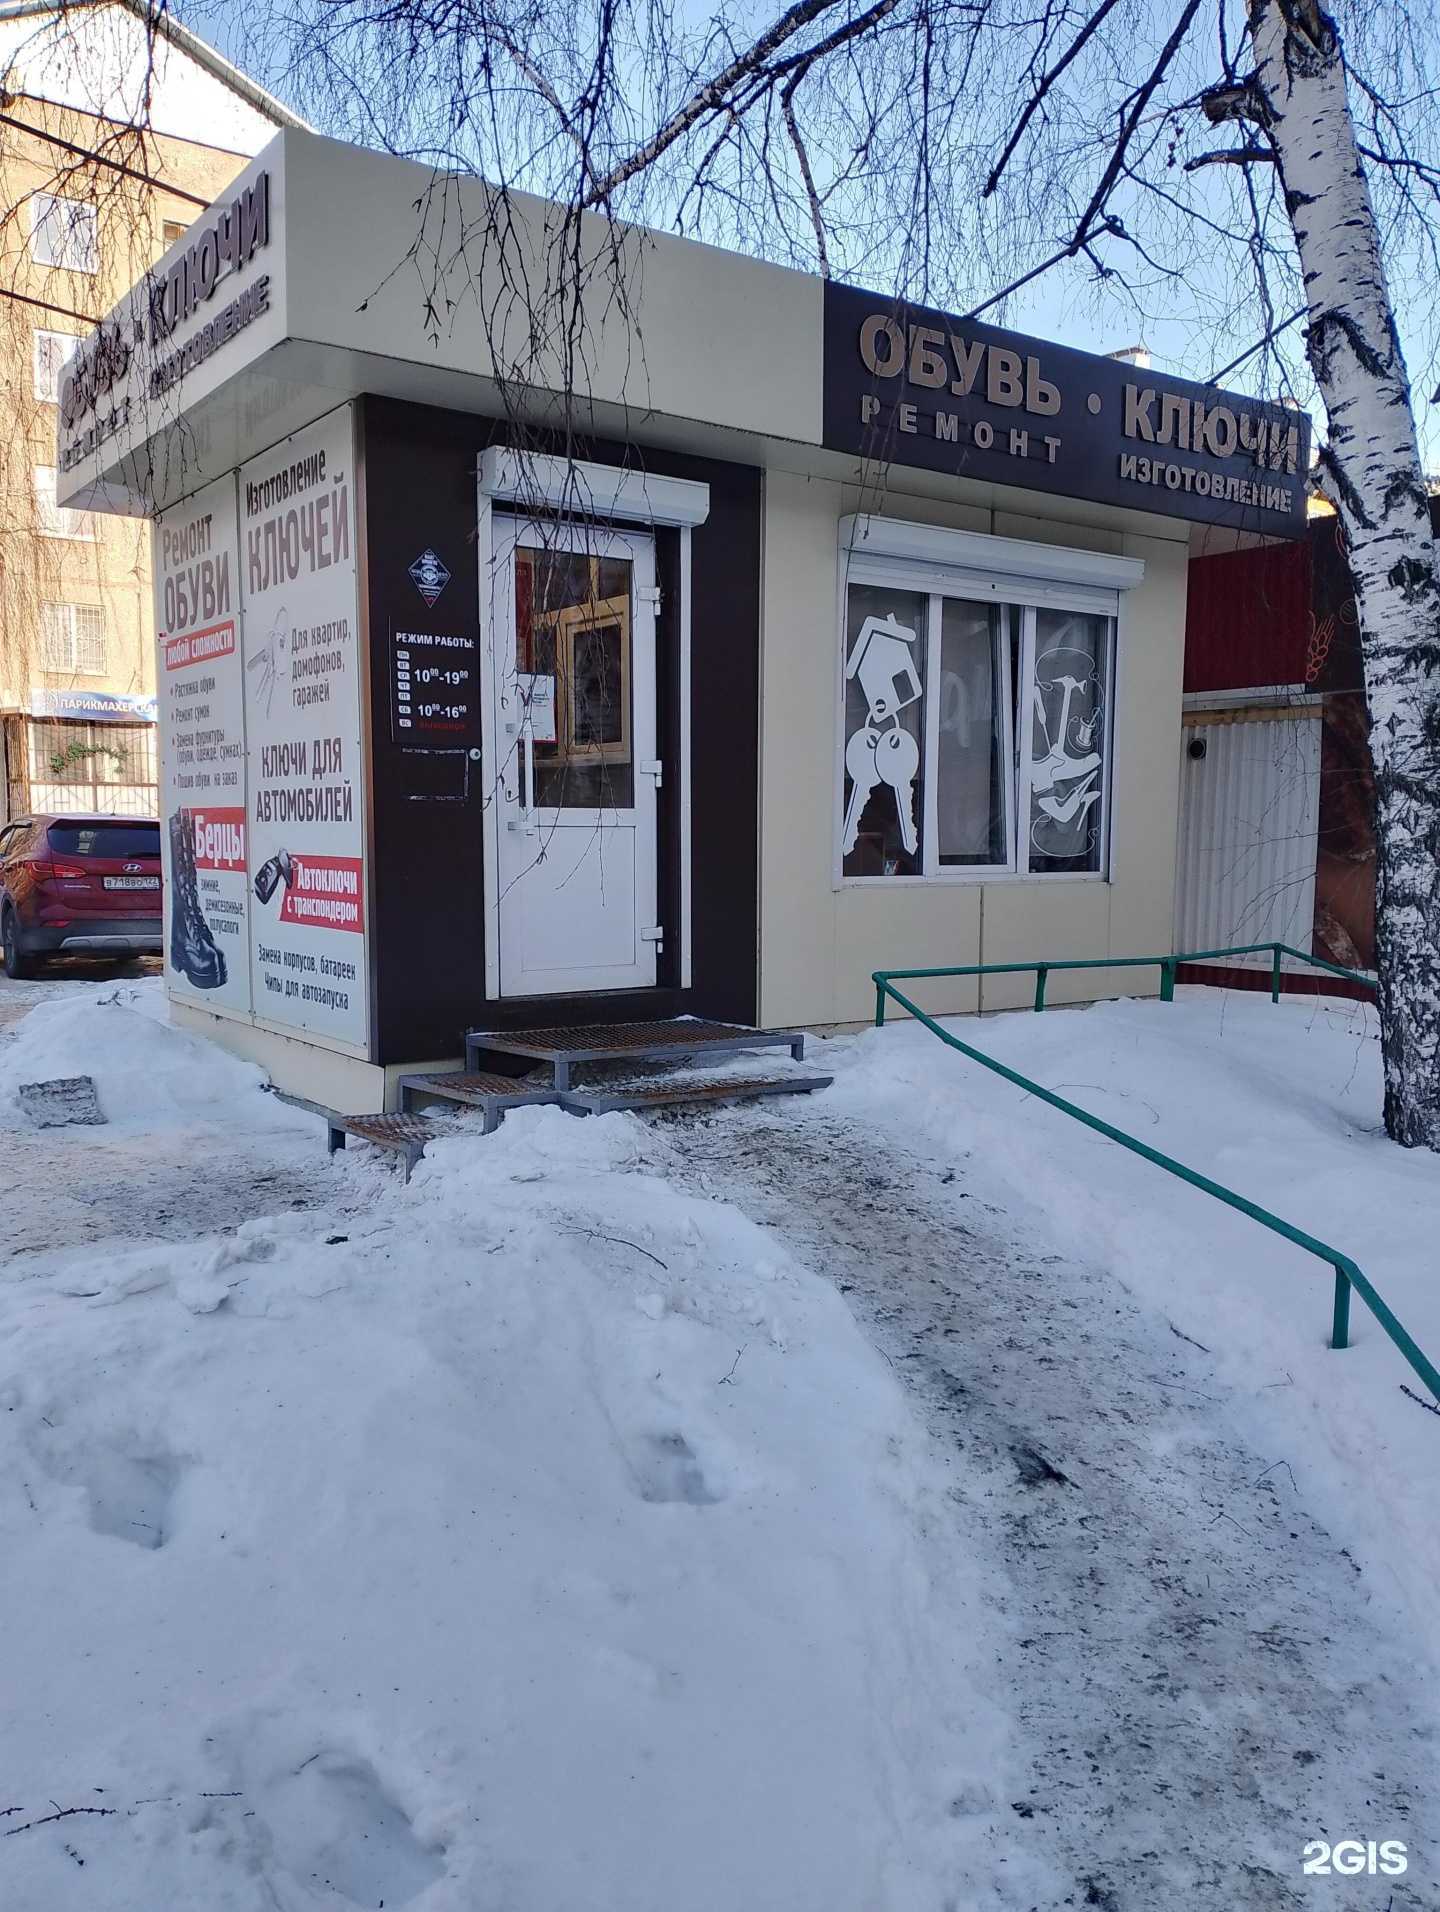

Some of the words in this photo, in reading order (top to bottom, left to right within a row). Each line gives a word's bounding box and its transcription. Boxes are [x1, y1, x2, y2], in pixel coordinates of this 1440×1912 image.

[151, 169, 269, 346] КЛЮЧИ
[860, 314, 1062, 416] ОБУВЬ
[1124, 383, 1299, 476] КЛЮЧИ
[861, 394, 1062, 464] РЕМОНТ
[247, 449, 327, 518] Изготовление
[1120, 452, 1293, 513] ИЗГОТОВЛЕНИЕ
[163, 513, 213, 571] Ремонт
[248, 472, 350, 594] КЛЮЧЕЙ
[165, 551, 230, 633] ОБУВИ
[167, 638, 190, 665] любой
[191, 627, 233, 658] сложности
[291, 628, 308, 652] Для
[311, 618, 351, 647] квартир,
[395, 631, 433, 645] РЕЖИМ
[434, 635, 475, 648] РАБОТЫ:
[175, 680, 198, 698] Растяжка
[200, 676, 215, 695] обуви
[292, 651, 345, 682] домофонов,
[292, 679, 330, 709] гаражей
[176, 707, 193, 723] Ремонт
[262, 741, 307, 778] КЛЮЧИ
[311, 737, 342, 780] ДЛЯ
[256, 779, 353, 823] АВТОМОБИЛЕЙ
[194, 815, 245, 867] Берцы
[297, 862, 358, 895] Автоключи
[286, 895, 292, 914] с
[294, 896, 358, 923] транспондером
[258, 943, 281, 965] Замена
[283, 951, 318, 975] корпусов,
[320, 954, 356, 981] батареек
[264, 971, 283, 993] Чипы
[285, 979, 299, 998] для
[301, 983, 349, 1010] автозапуска
